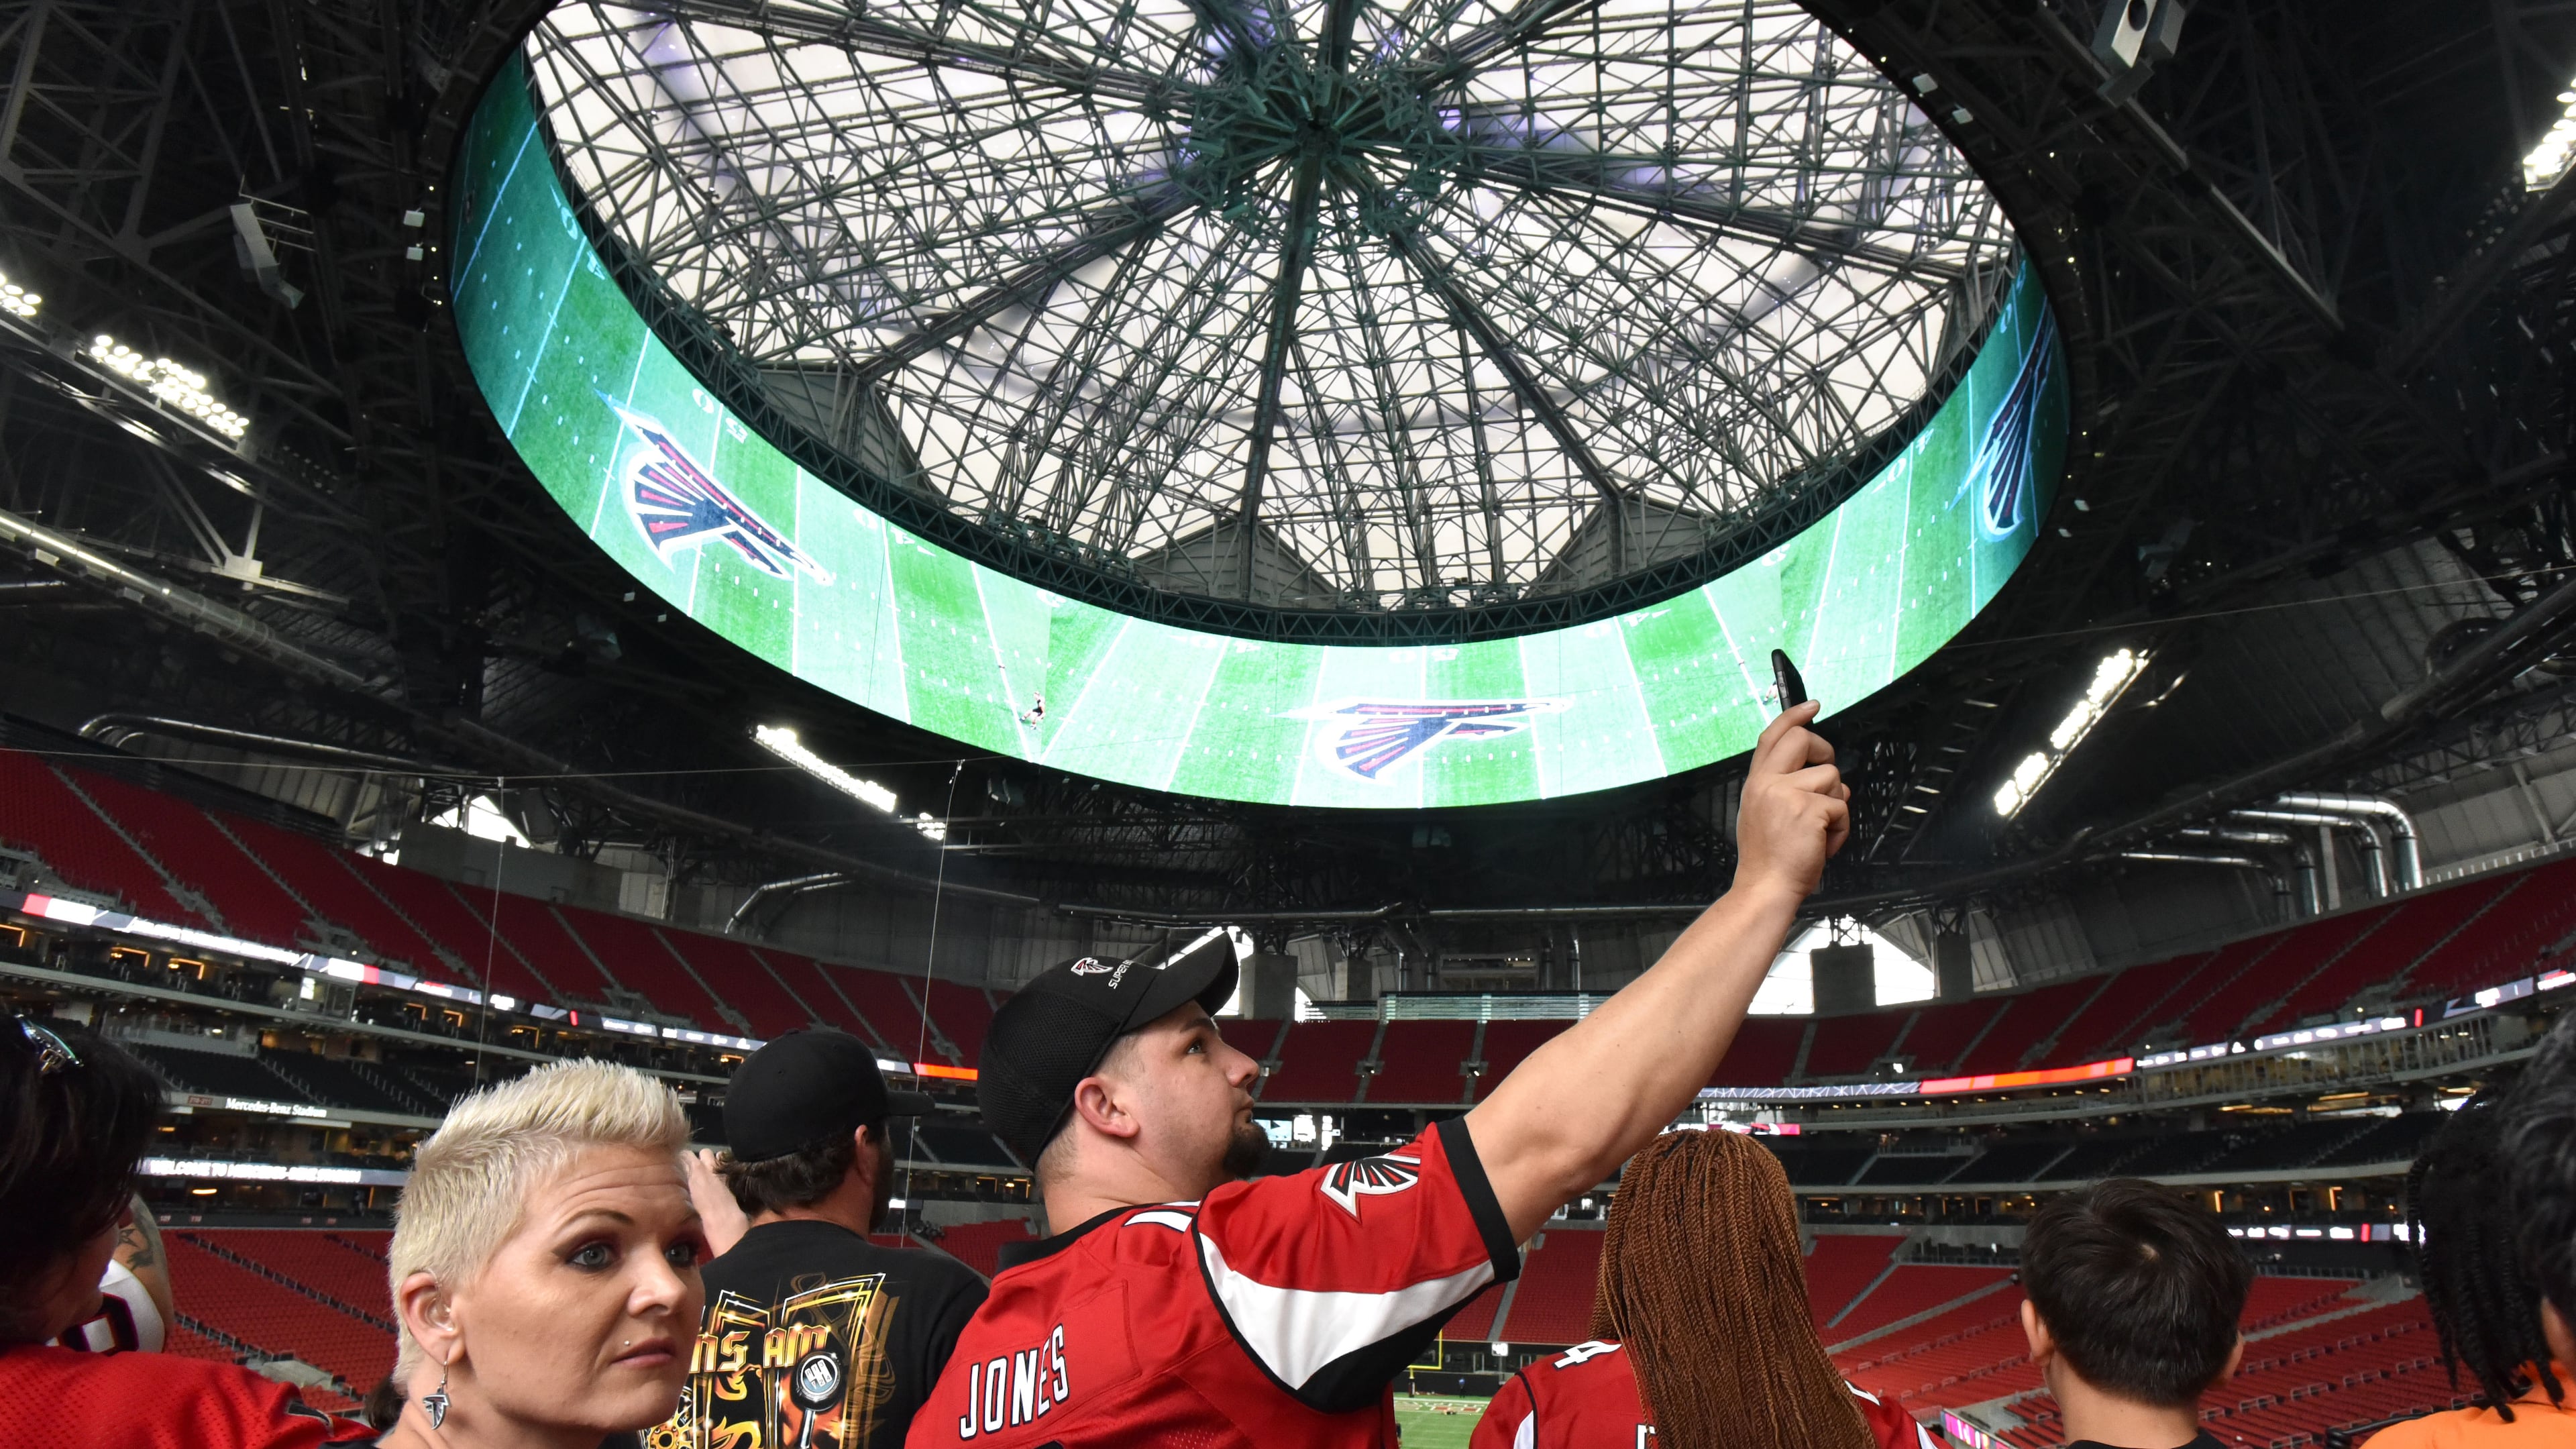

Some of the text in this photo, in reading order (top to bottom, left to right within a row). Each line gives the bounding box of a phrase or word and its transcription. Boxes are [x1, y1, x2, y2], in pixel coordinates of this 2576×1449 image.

[1108, 963, 1130, 989] SUPER
[225, 1097, 327, 1118] Mercedes-Benz Stadium
[150, 1160, 211, 1176] WELCOME
[212, 1163, 227, 1177] TO
[959, 1323, 1069, 1440] JONES
